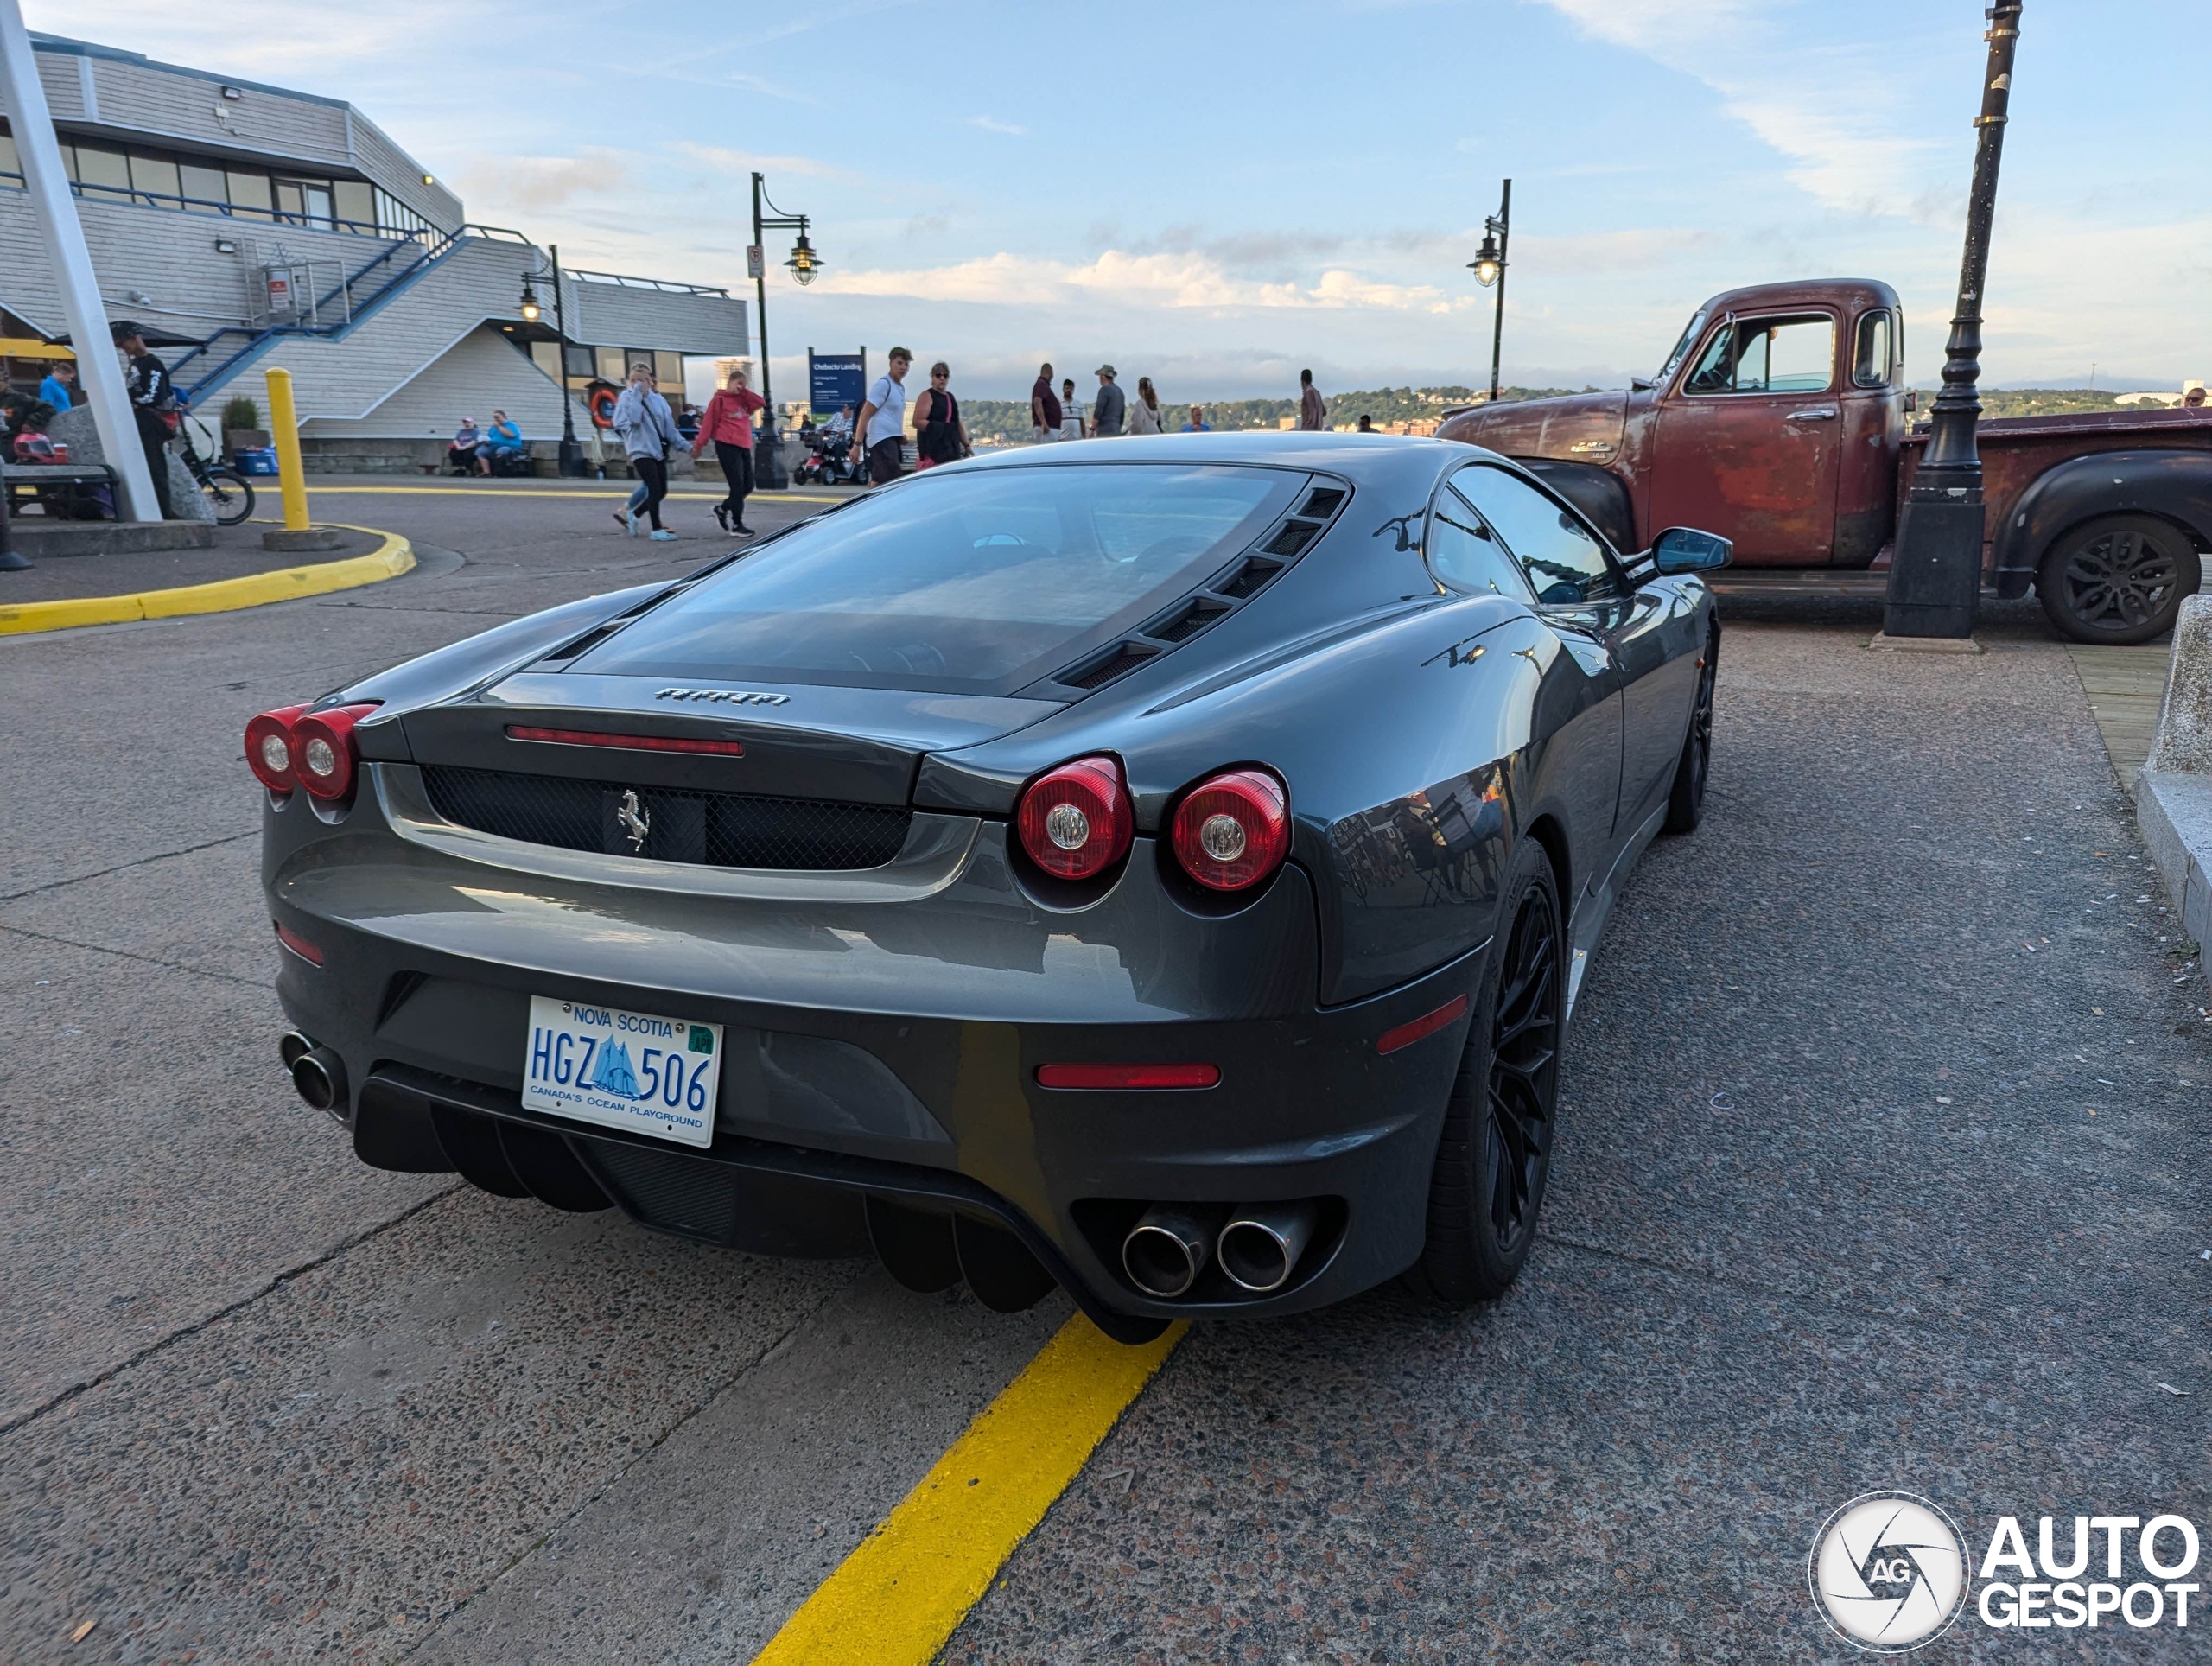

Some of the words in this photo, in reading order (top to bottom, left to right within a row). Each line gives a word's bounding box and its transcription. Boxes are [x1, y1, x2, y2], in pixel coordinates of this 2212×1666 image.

[841, 363, 862, 372] Landing
[655, 687, 791, 708] Ferrari
[574, 1006, 612, 1027] NOVA
[617, 1014, 672, 1038] SCOTIA
[695, 1036, 712, 1054] APR
[531, 1027, 597, 1090] HGZ
[639, 1047, 709, 1112] 506
[531, 1085, 582, 1103] CANADA'S
[587, 1097, 625, 1111] OCEAN
[630, 1106, 702, 1128] PLAYGROUND
